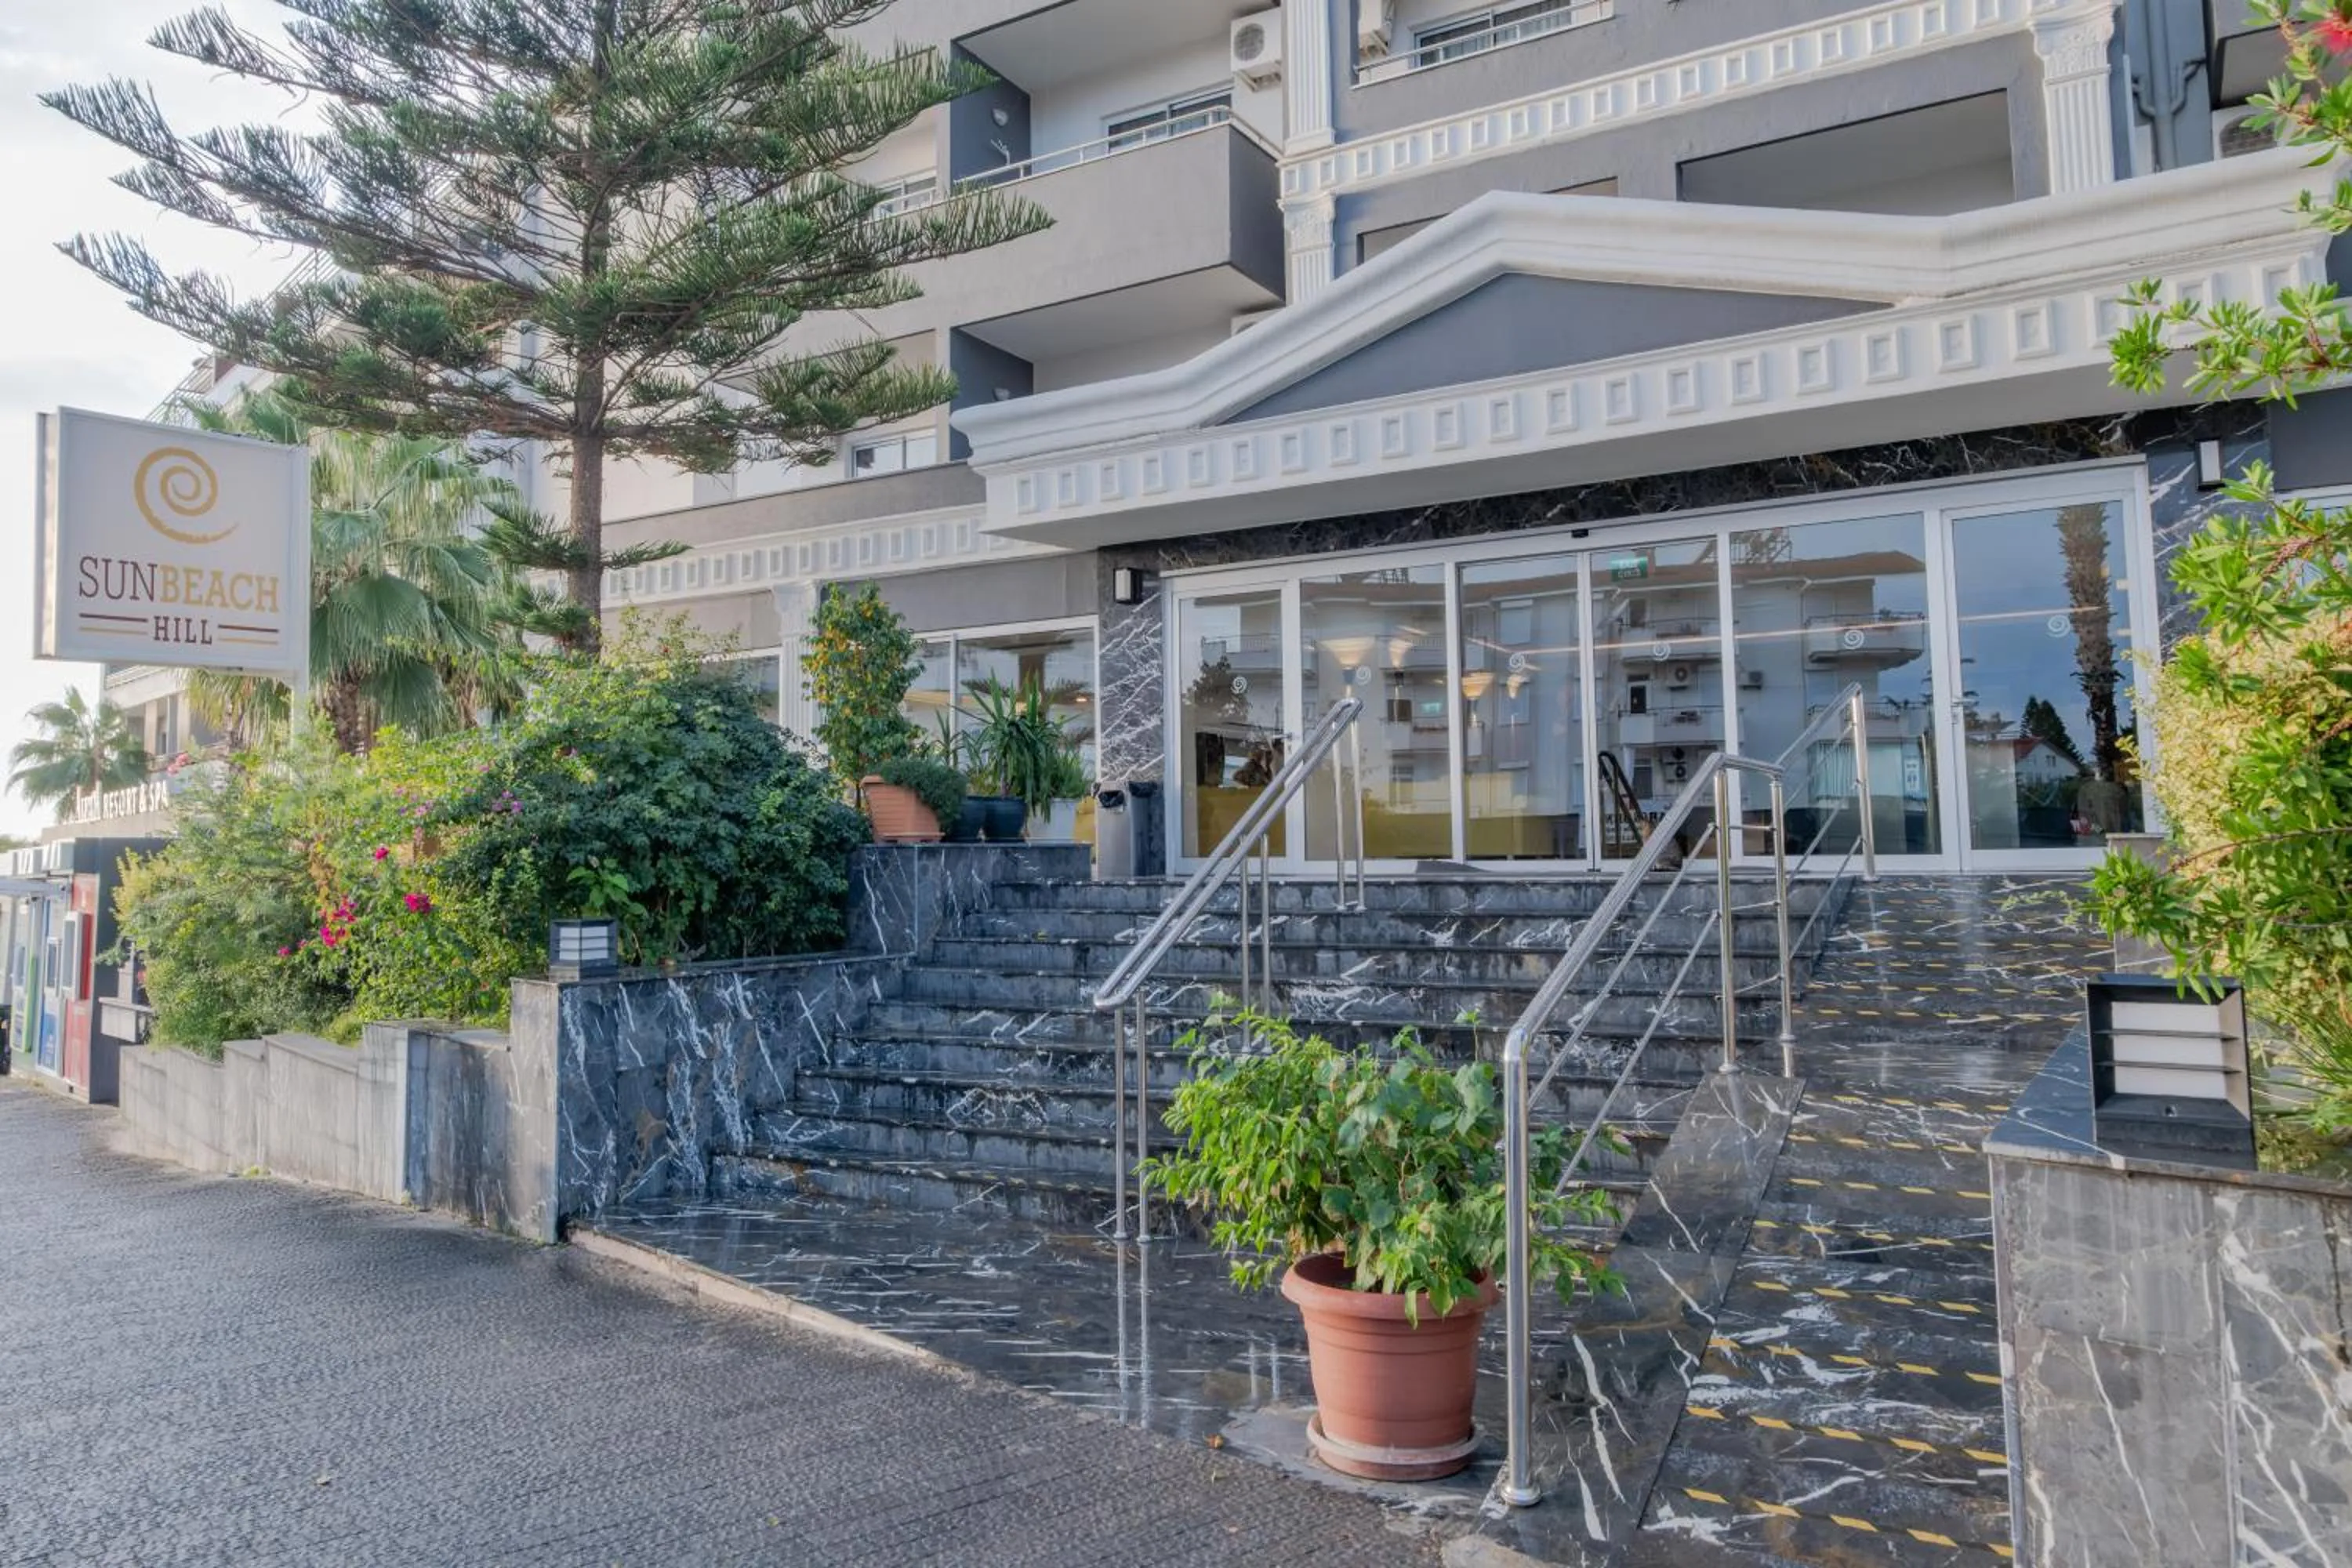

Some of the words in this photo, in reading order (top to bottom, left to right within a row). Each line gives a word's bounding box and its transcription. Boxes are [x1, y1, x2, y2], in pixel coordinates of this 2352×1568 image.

[79, 555, 279, 613] SUNBEACH
[153, 615, 212, 644] HILL
[103, 786, 137, 818] RESORT
[139, 783, 147, 812] &
[149, 780, 169, 812] SPA
